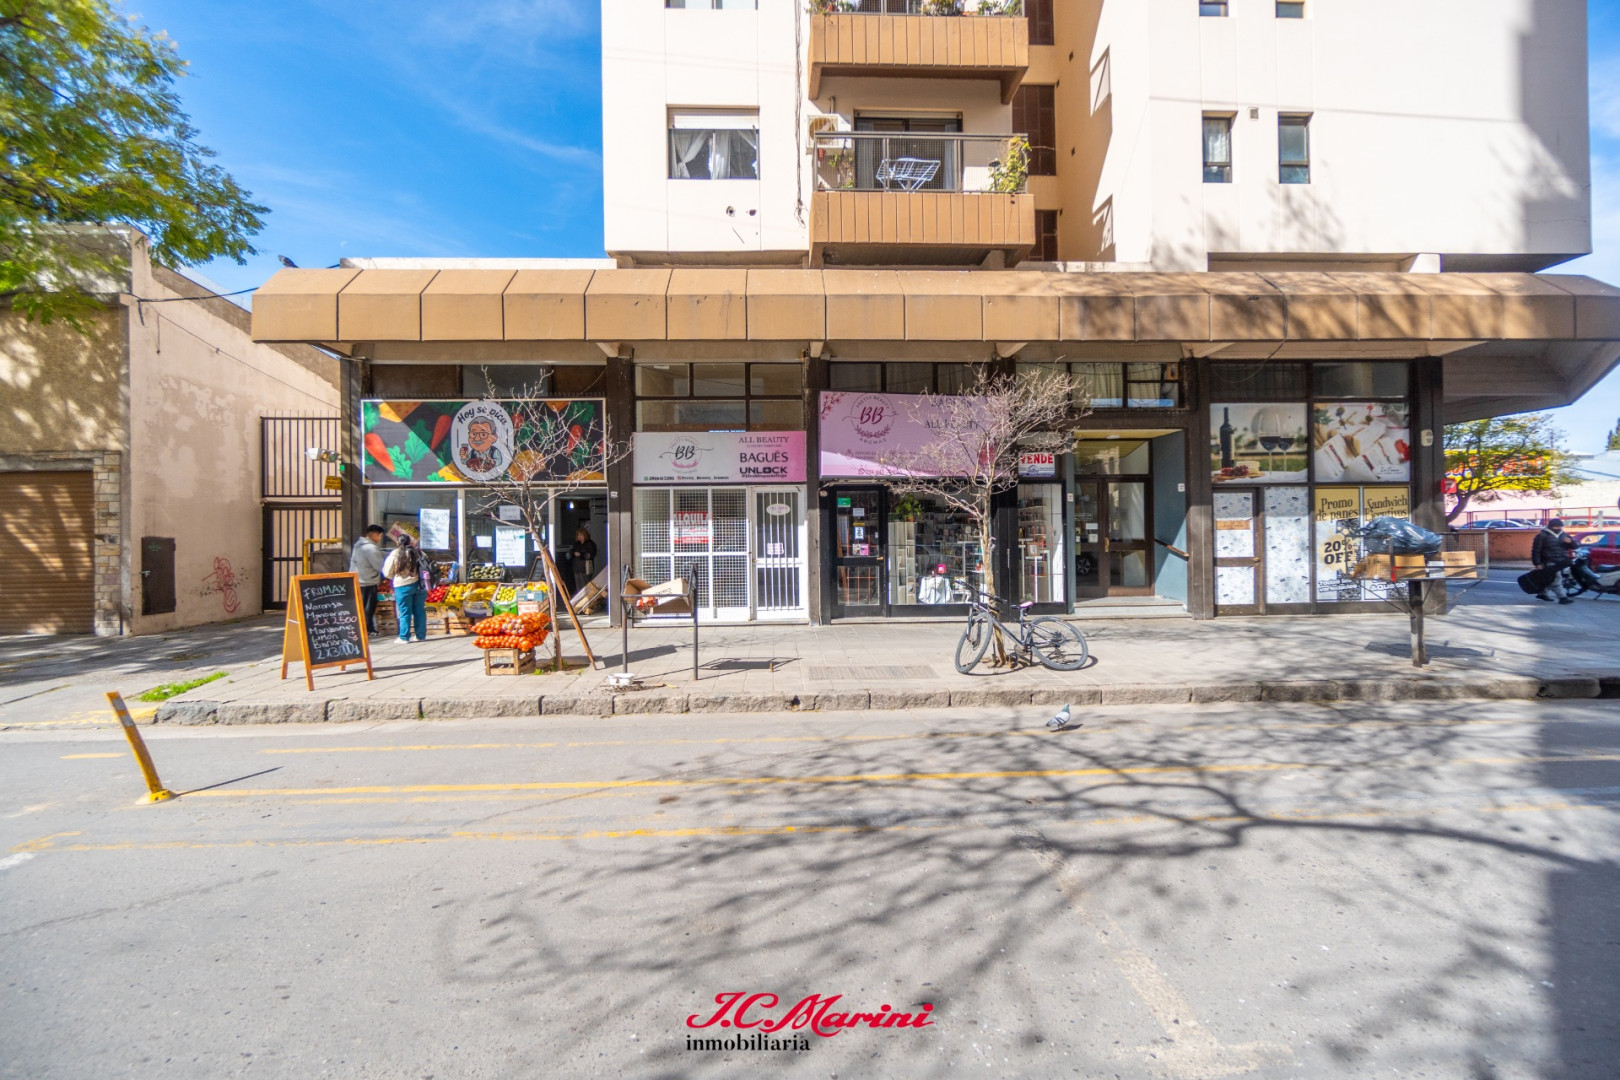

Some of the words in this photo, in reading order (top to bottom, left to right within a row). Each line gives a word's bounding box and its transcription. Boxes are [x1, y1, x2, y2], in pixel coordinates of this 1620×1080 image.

[856, 396, 872, 408] PRETTY
[457, 408, 475, 424] Hoy
[477, 406, 488, 414] se
[489, 408, 508, 425] pica
[860, 406, 884, 425] BB
[739, 436, 755, 444] ALL
[757, 436, 790, 444] BEAUTY
[675, 445, 696, 460] BB
[1021, 453, 1054, 465] VENDE
[1321, 498, 1354, 512] Promo
[1366, 495, 1408, 512] Sandwich
[1316, 510, 1328, 521] de
[1330, 509, 1359, 523] panes
[1324, 539, 1353, 553] 20%
[1324, 551, 1355, 565] OFF
[332, 616, 358, 625] 2500
